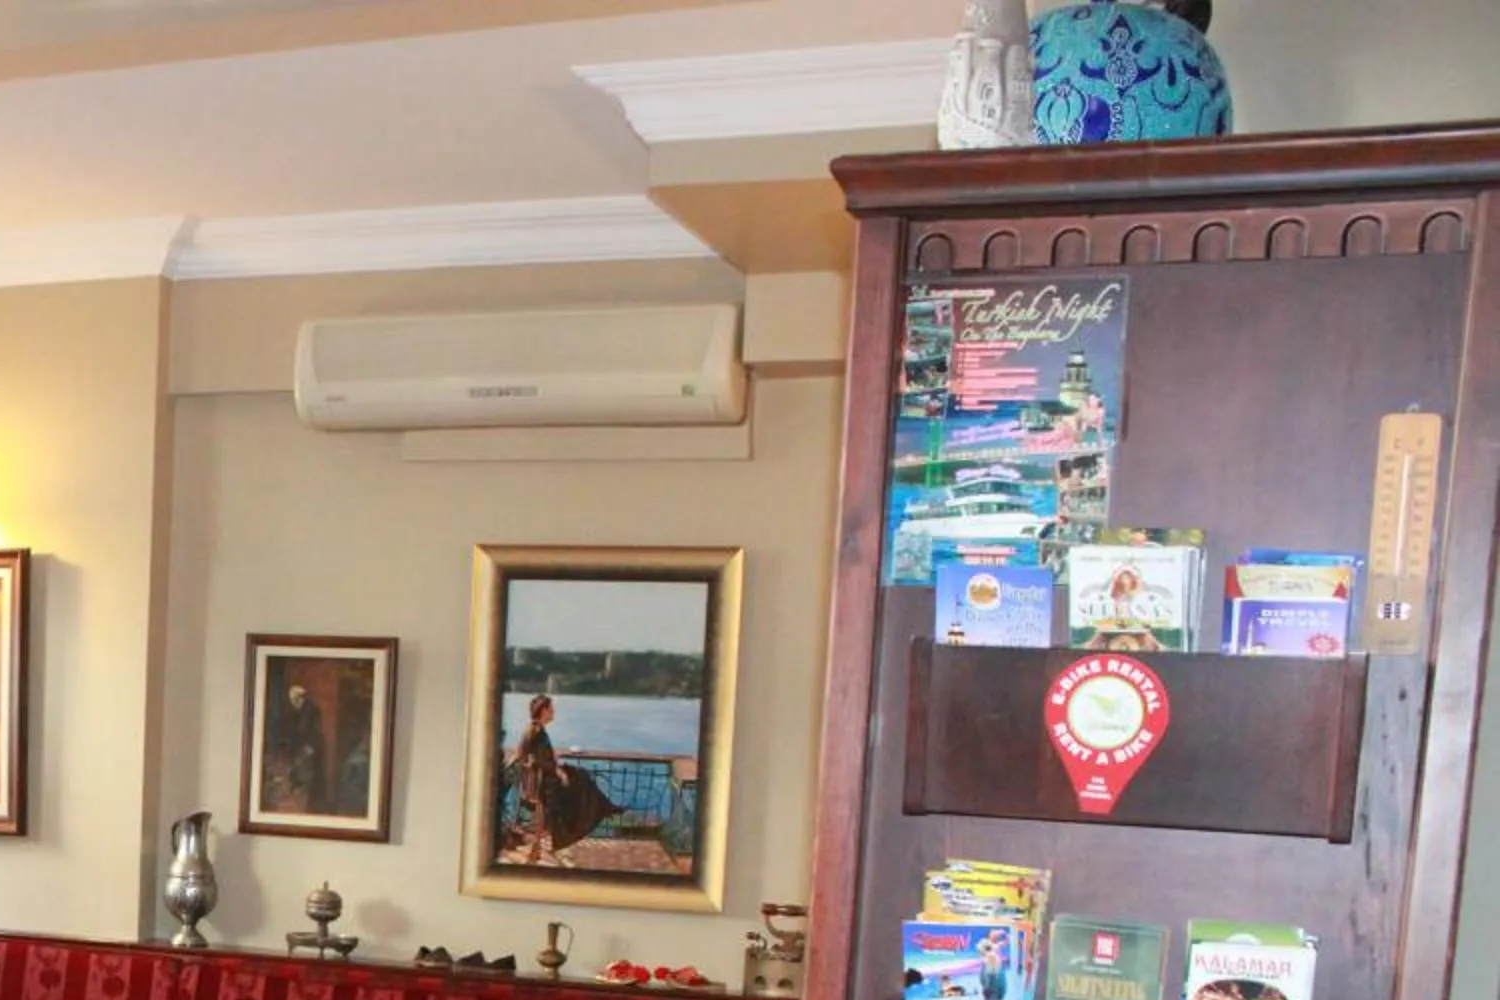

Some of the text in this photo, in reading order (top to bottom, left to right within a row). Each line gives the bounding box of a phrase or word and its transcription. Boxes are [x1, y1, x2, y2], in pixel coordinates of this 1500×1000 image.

[961, 284, 1121, 337] Turkish Night
[1052, 659, 1161, 714] E-BIKE RENTAL
[1054, 722, 1153, 765] RENT A BIKE
